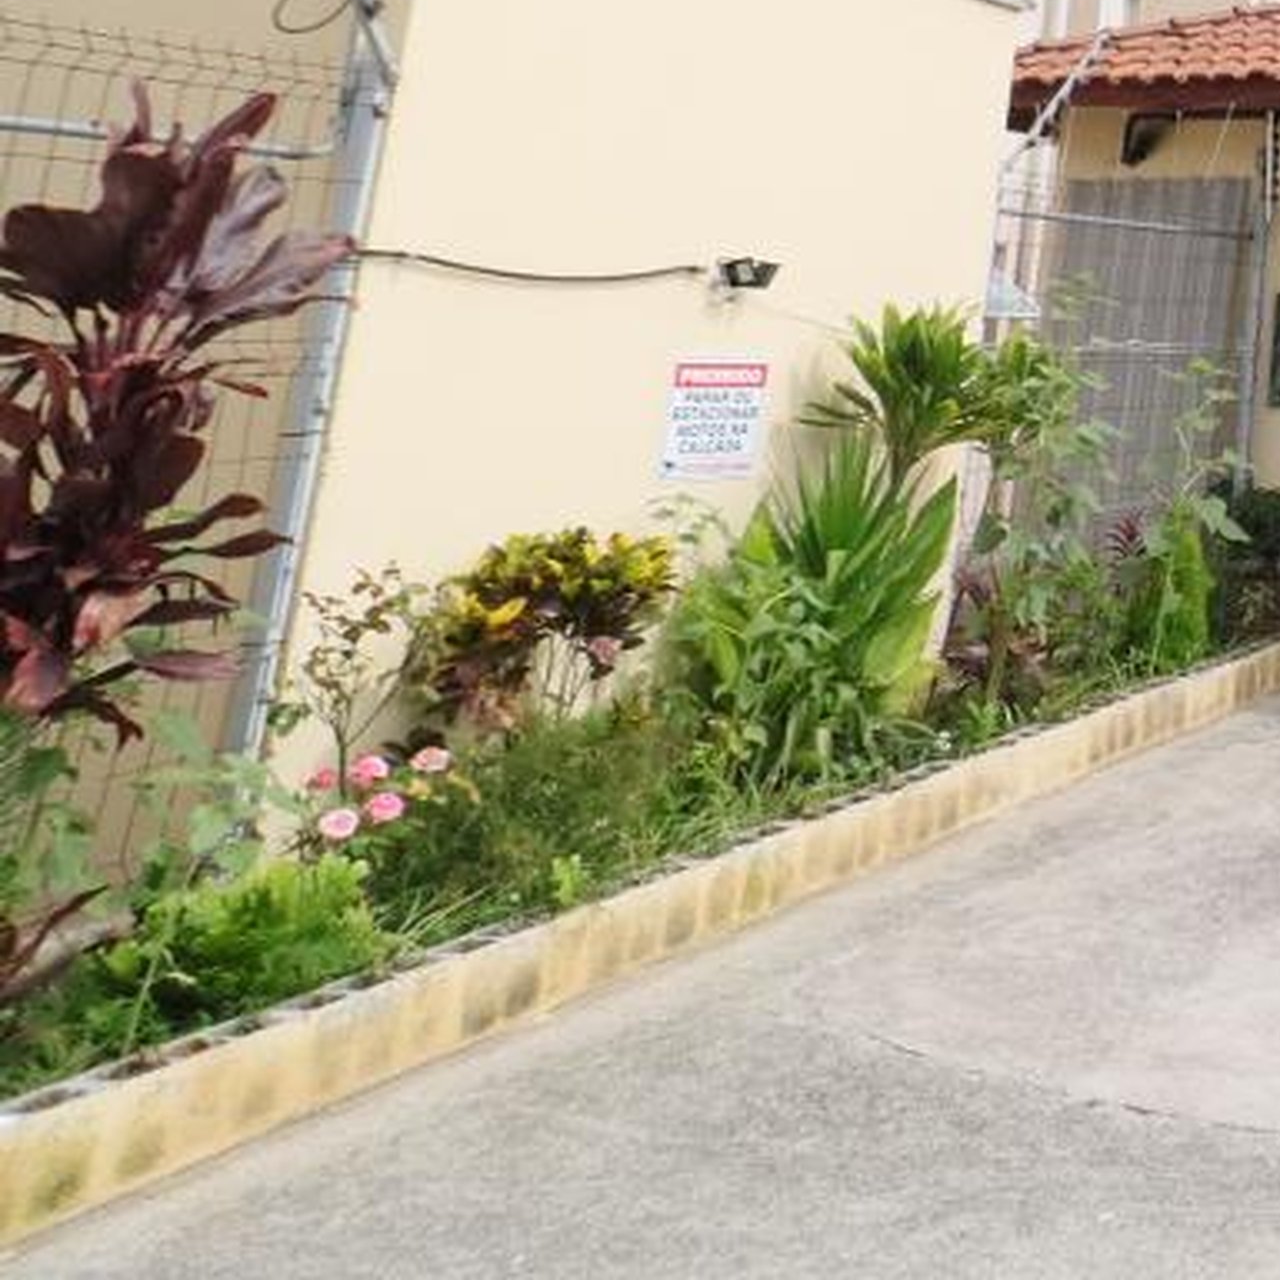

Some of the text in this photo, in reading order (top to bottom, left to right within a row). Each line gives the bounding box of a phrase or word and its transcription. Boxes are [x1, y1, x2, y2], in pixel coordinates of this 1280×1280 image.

[684, 390, 752, 404] PARAR OU
[672, 406, 759, 420] ESTACIONAR
[676, 422, 726, 437] MOTOS
